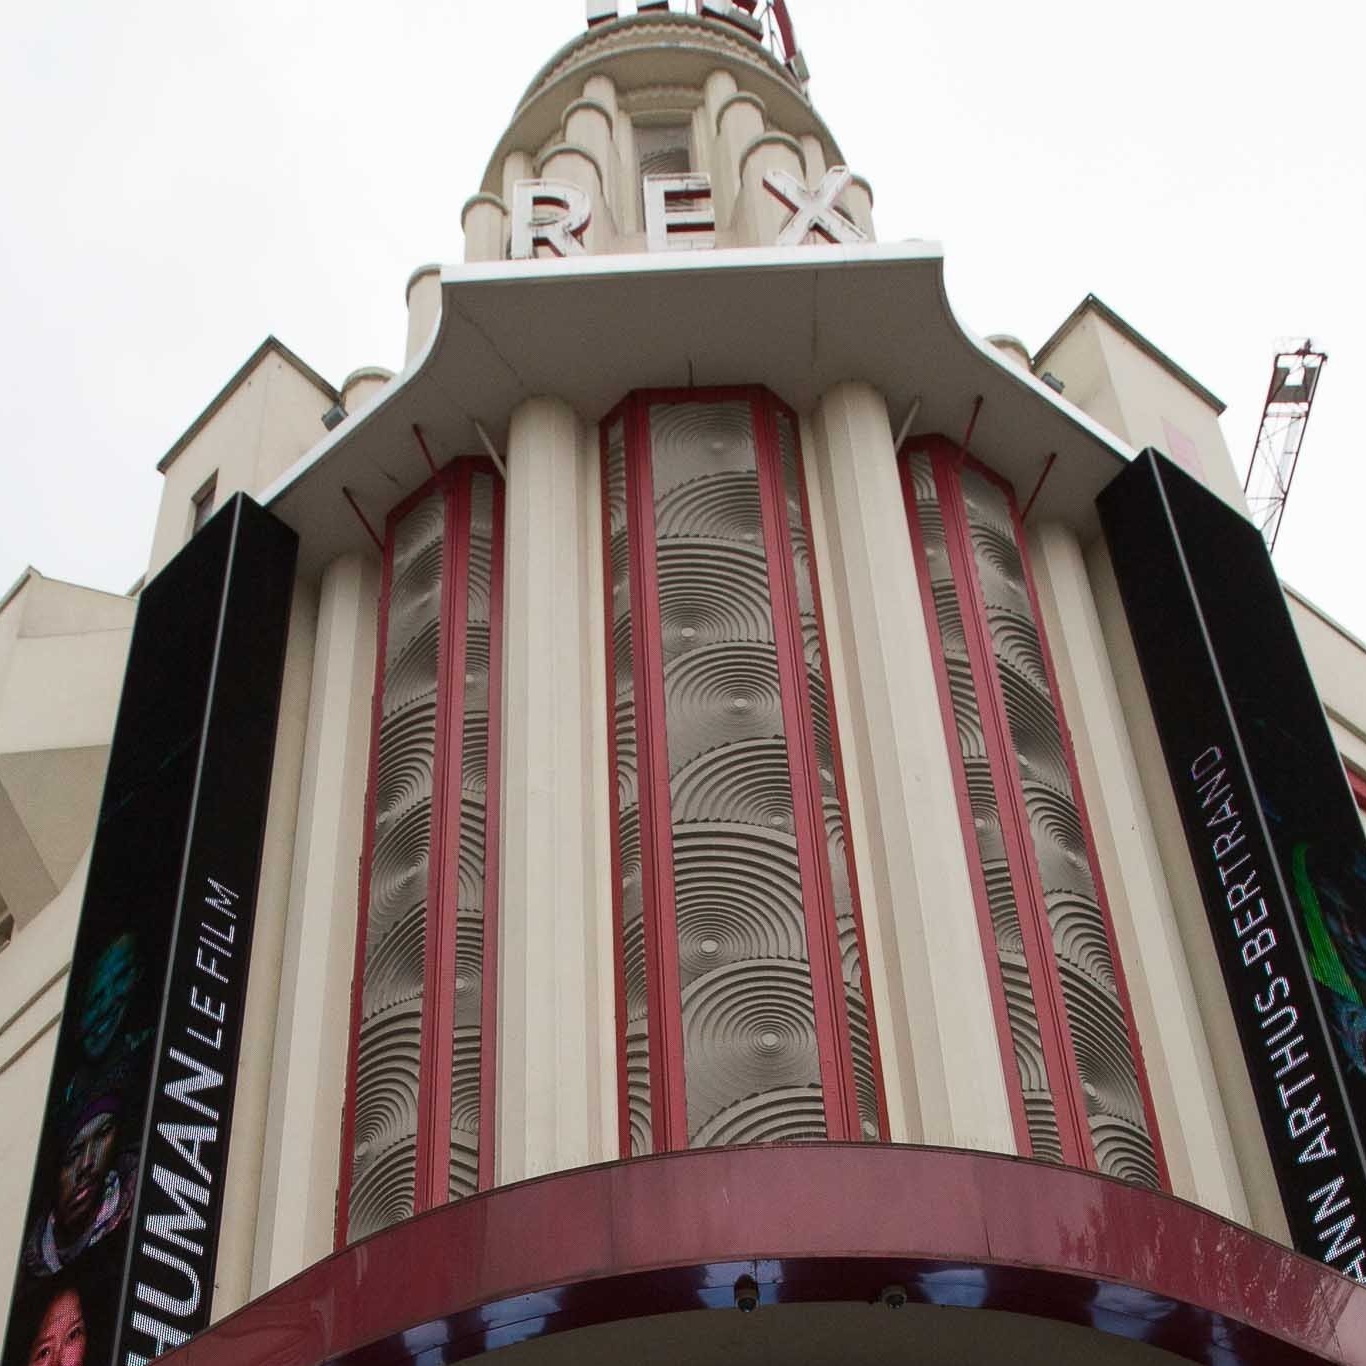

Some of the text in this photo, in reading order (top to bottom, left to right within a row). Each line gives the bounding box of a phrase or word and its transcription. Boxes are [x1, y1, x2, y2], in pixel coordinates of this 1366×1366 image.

[510, 165, 869, 260] REX
[196, 876, 240, 984] FILM
[1190, 745, 1337, 1165] ARTHUS-BERTRAND
[187, 986, 228, 1049] LE
